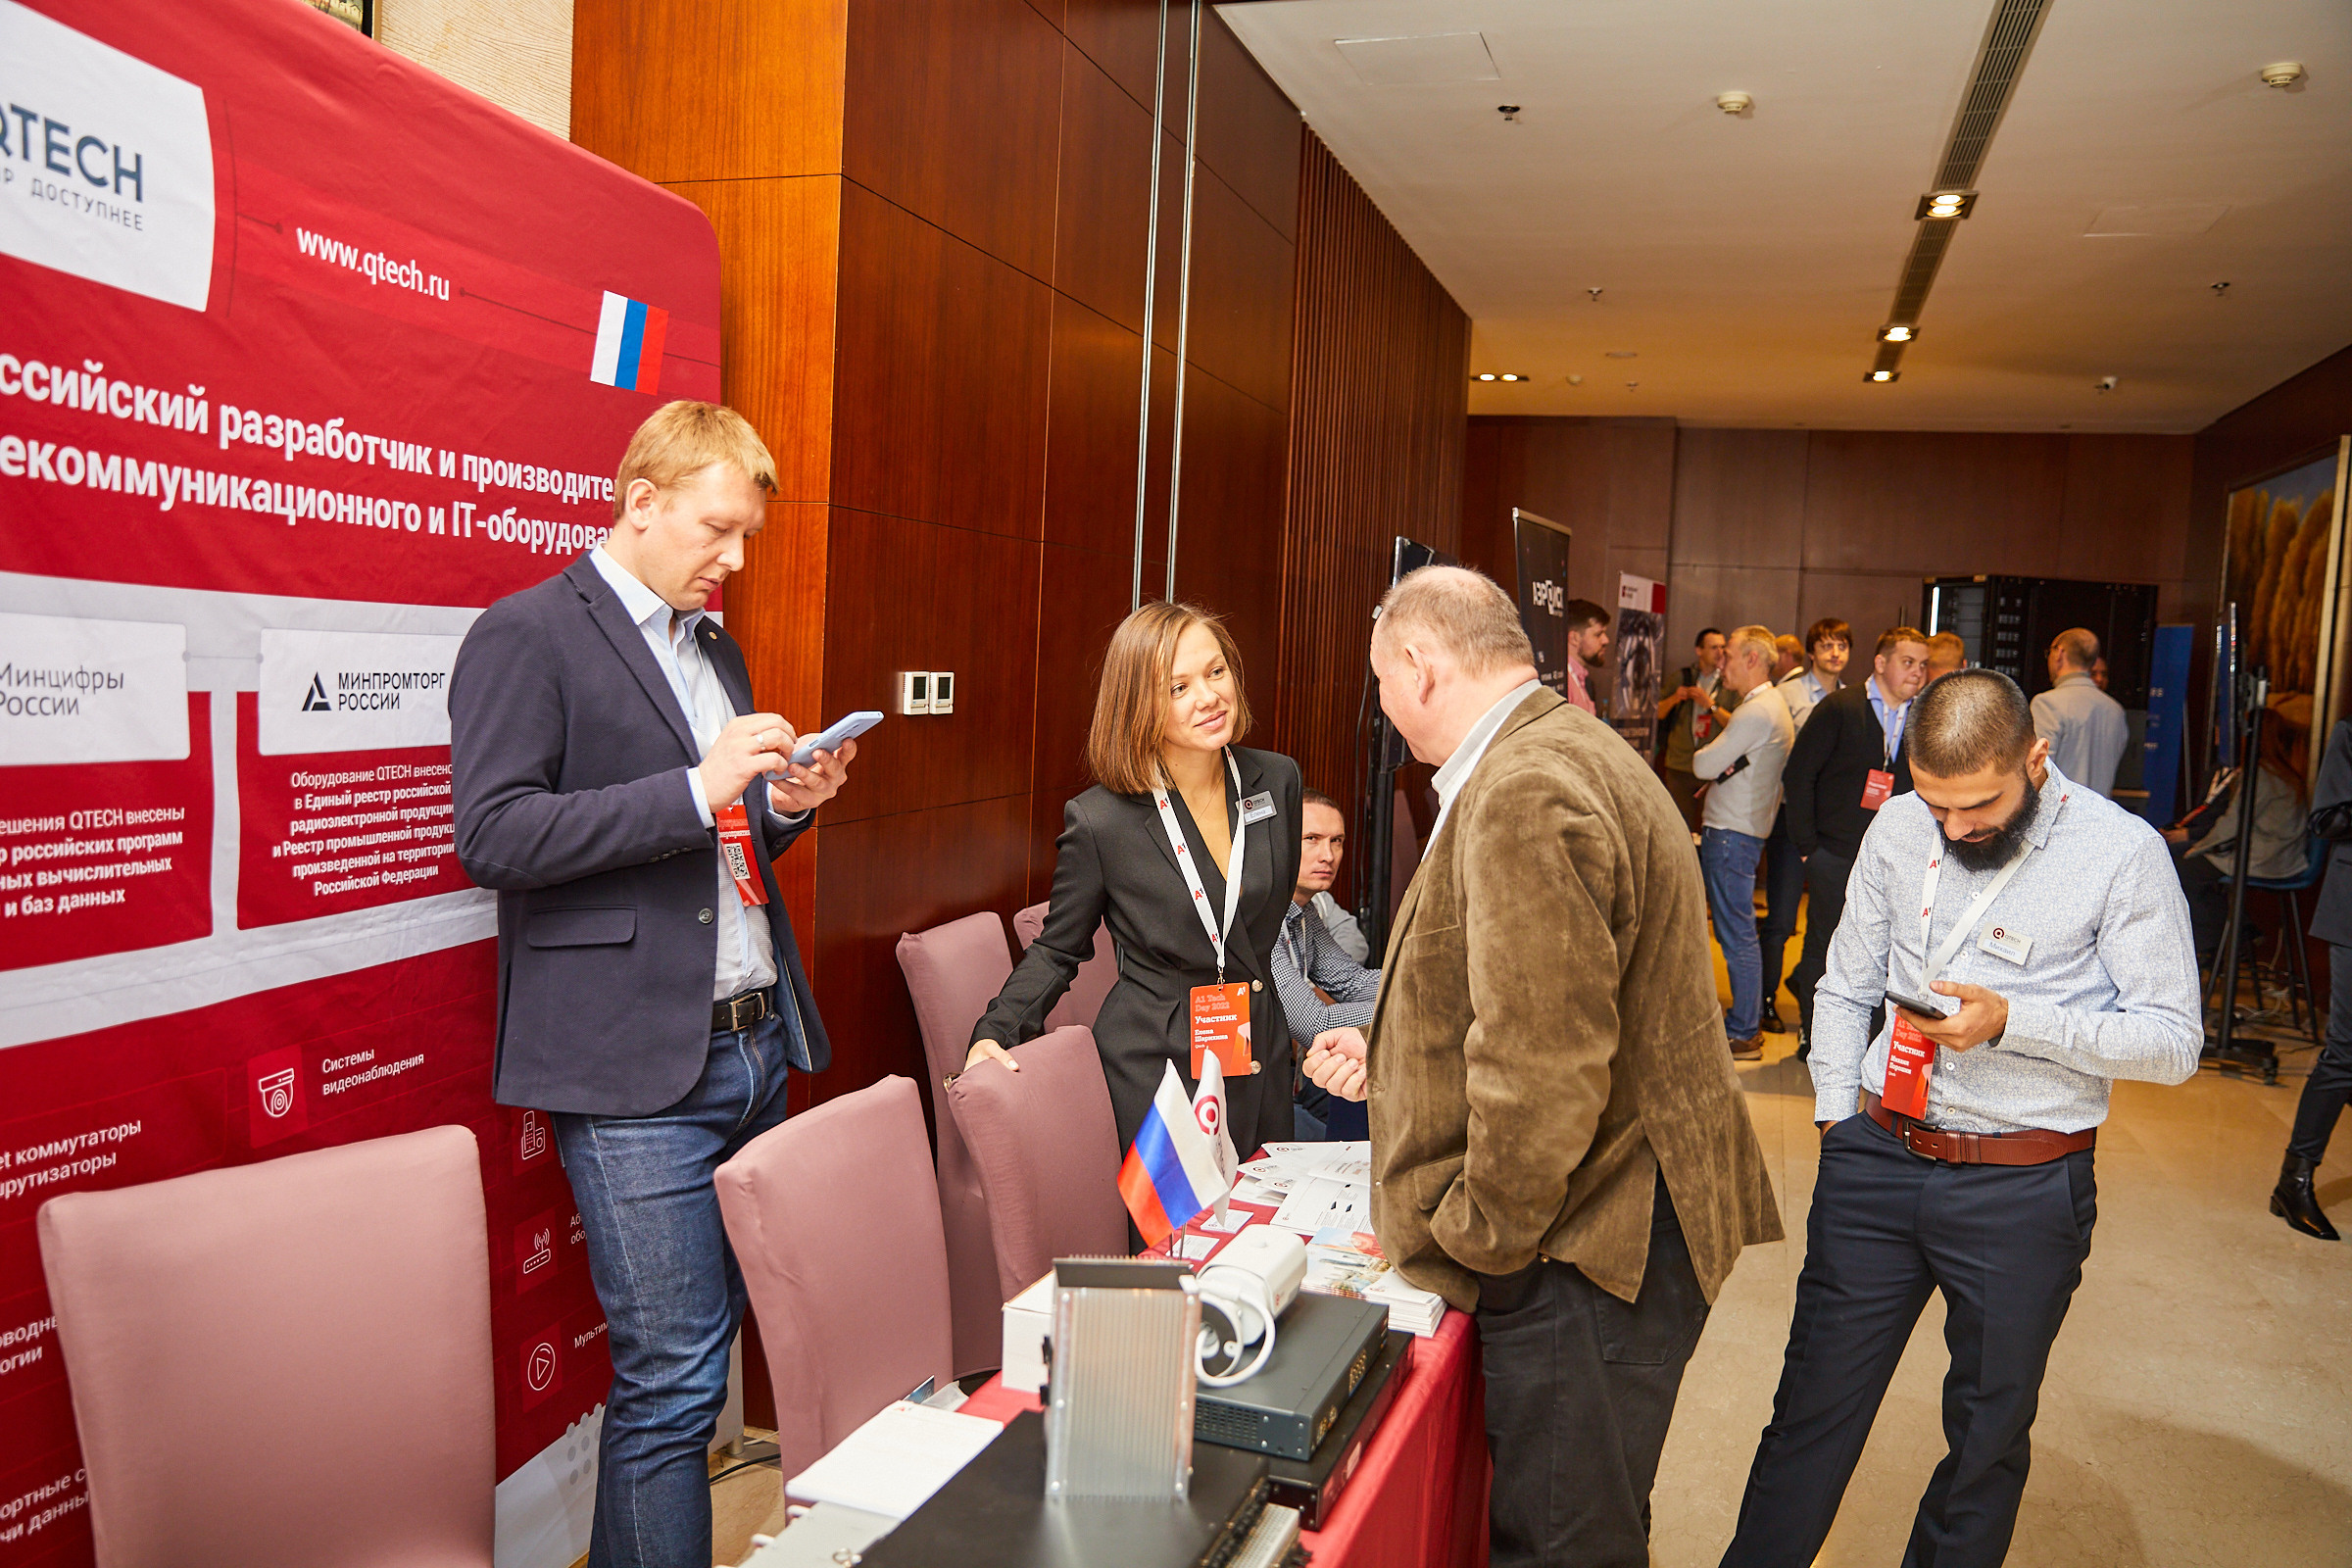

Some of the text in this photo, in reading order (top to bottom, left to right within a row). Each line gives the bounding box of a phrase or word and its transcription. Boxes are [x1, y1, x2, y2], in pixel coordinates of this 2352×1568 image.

[32, 177, 143, 231] ДОСТУПНЕЕ
[296, 227, 450, 301] www.qtech.ru
[0, 354, 616, 505] ссийский разработчик и производите
[0, 435, 421, 532] екоммуникационного
[428, 506, 445, 535] и
[338, 672, 446, 690] МИНПРОМТОРГ
[338, 693, 401, 710] РОССИИ
[291, 769, 375, 790] Оборудование
[376, 764, 412, 781] QTECH
[295, 780, 452, 811] в Единый реестр российской
[1159, 798, 1169, 810] A1
[69, 808, 124, 830] QTECH
[125, 807, 185, 825] внесены
[290, 808, 399, 836] радиоэлектронной
[12, 837, 115, 867] российских
[117, 831, 184, 856] программ
[272, 844, 282, 858] и
[282, 839, 325, 858] Реестр
[326, 825, 413, 852] промышленной
[1177, 842, 1187, 856] A1
[36, 857, 172, 887] вычислительных
[292, 842, 456, 880] произведенной на территории
[1929, 858, 1941, 869] A1
[314, 864, 439, 897] Российской Федерации
[1195, 887, 1204, 901] A1
[5, 888, 125, 918] и баз данных
[1922, 906, 1932, 918] A1
[1237, 986, 1247, 997] A1
[1194, 1013, 1238, 1025] Участник
[322, 1048, 375, 1074] Системы
[1892, 1040, 1926, 1058] Участник
[322, 1053, 424, 1096] видеонаблюдения
[16, 1119, 141, 1165] коммутаторы
[570, 1229, 588, 1246] обо
